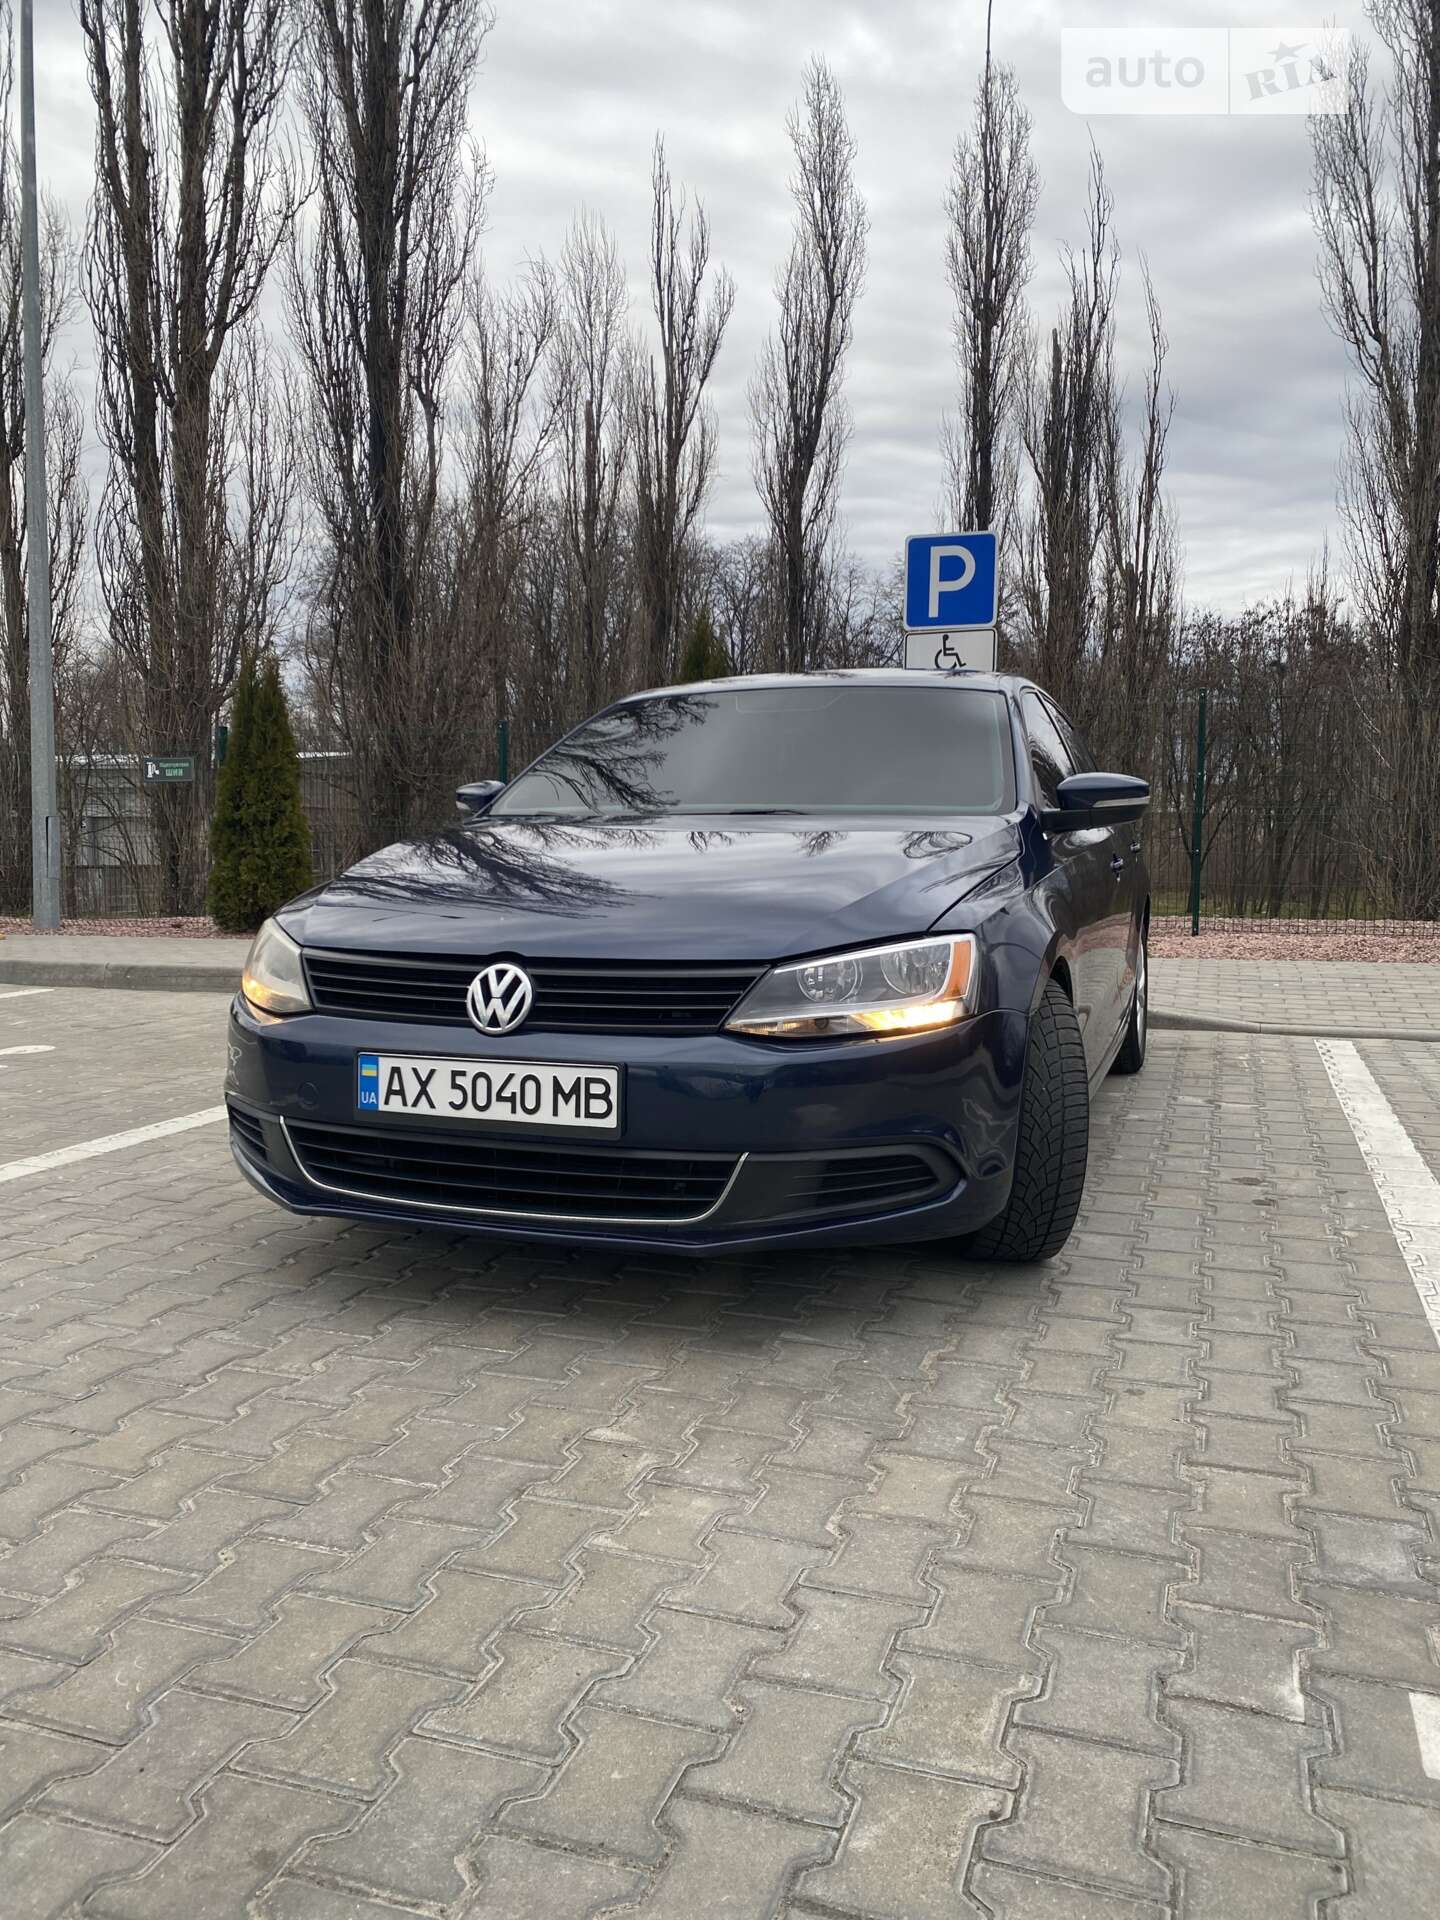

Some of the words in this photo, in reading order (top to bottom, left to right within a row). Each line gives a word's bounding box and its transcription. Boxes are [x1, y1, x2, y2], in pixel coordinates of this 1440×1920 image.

[928, 545, 976, 618] P
[361, 1090, 378, 1105] UA
[383, 1066, 438, 1110] AX
[448, 1069, 542, 1116] 5040
[552, 1074, 614, 1120] MB
